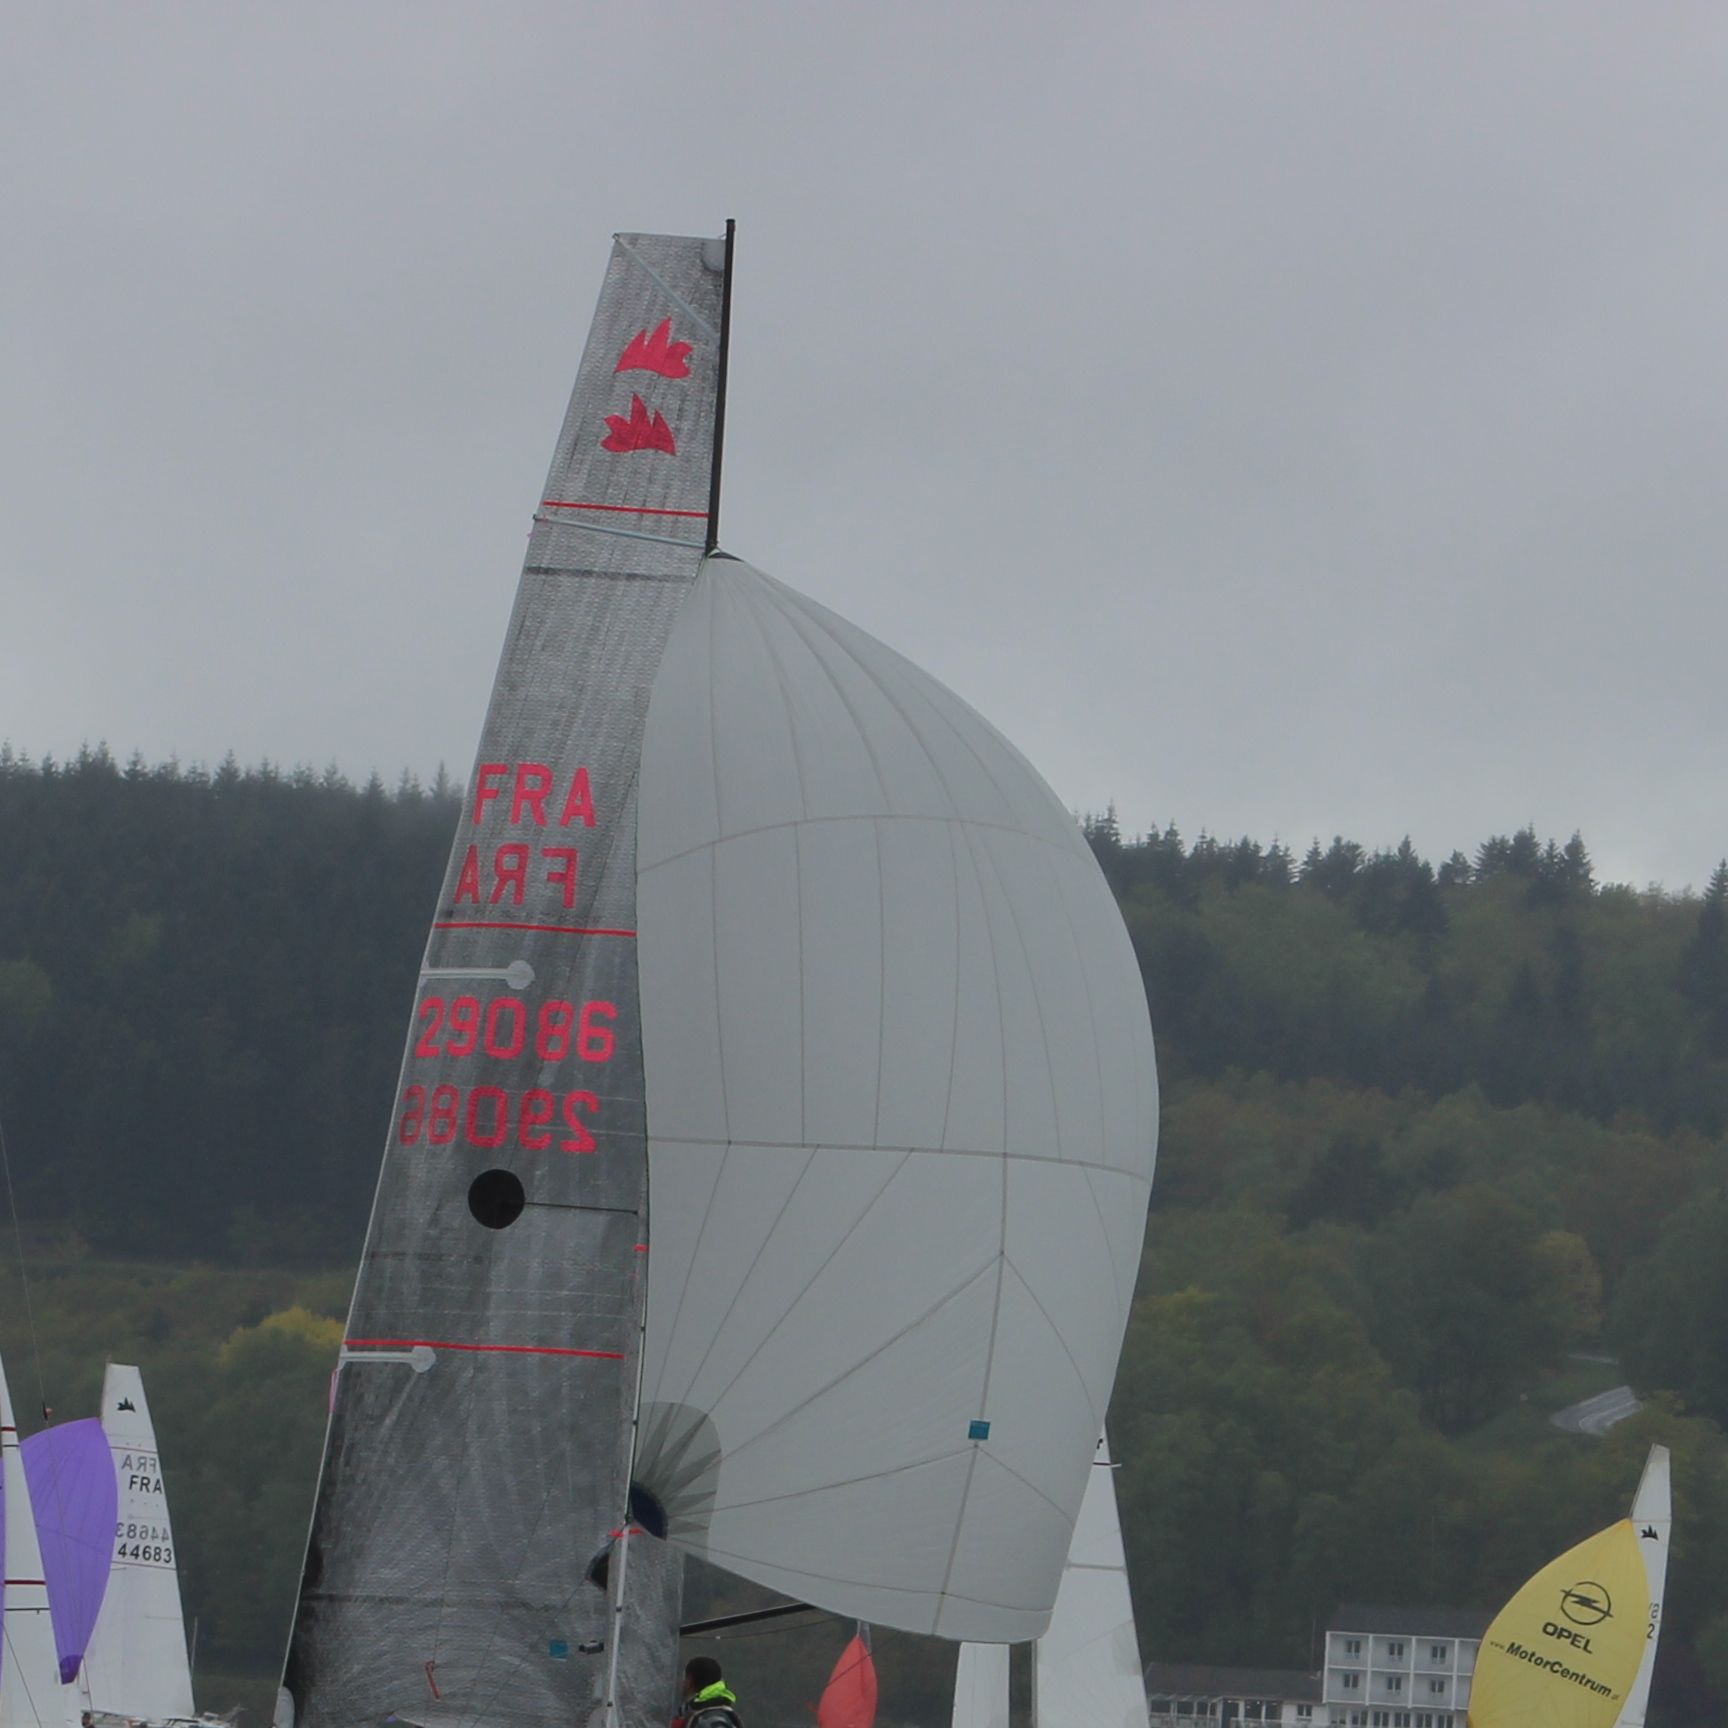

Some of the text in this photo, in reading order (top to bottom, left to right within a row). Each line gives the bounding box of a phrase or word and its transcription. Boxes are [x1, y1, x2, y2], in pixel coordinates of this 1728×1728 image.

[472, 762, 597, 828] FRA
[415, 996, 618, 1063] 29086
[129, 1475, 163, 1494] FRA
[118, 1543, 173, 1564] 44683
[1542, 1621, 1594, 1655] OPEL
